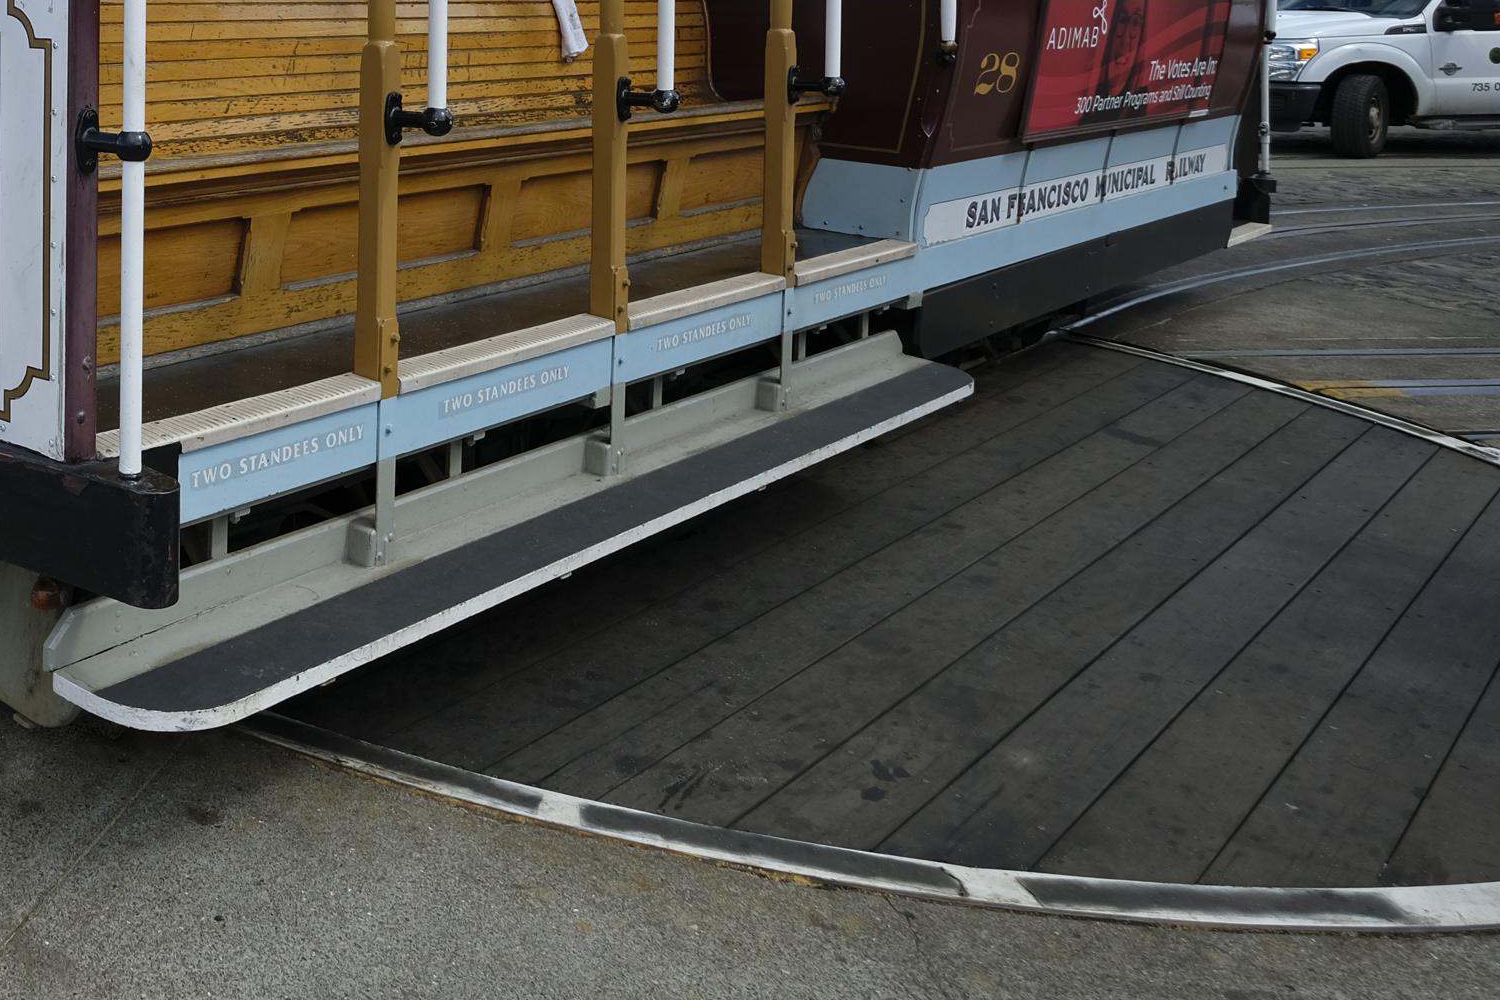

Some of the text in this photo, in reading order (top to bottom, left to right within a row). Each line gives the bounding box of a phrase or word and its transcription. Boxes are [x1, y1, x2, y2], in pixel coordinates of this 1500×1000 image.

[1046, 26, 1100, 50] ADIMAB
[974, 52, 1020, 96] 28
[1149, 60, 1165, 80] The
[1167, 59, 1190, 79] Votes
[1190, 57, 1206, 77] Are
[1074, 97, 1092, 114] 300
[1092, 95, 1124, 112] Partner
[1123, 90, 1158, 109] Programs
[1159, 85, 1173, 102] and
[1184, 82, 1212, 99] Counting
[1471, 82, 1490, 92] 735
[966, 197, 1001, 228] SAN
[658, 314, 751, 351] TWO STANDEES ONLY
[443, 365, 570, 413] TWO STANDEES ONLY
[191, 424, 364, 488] TWO STANDEES ONLY
